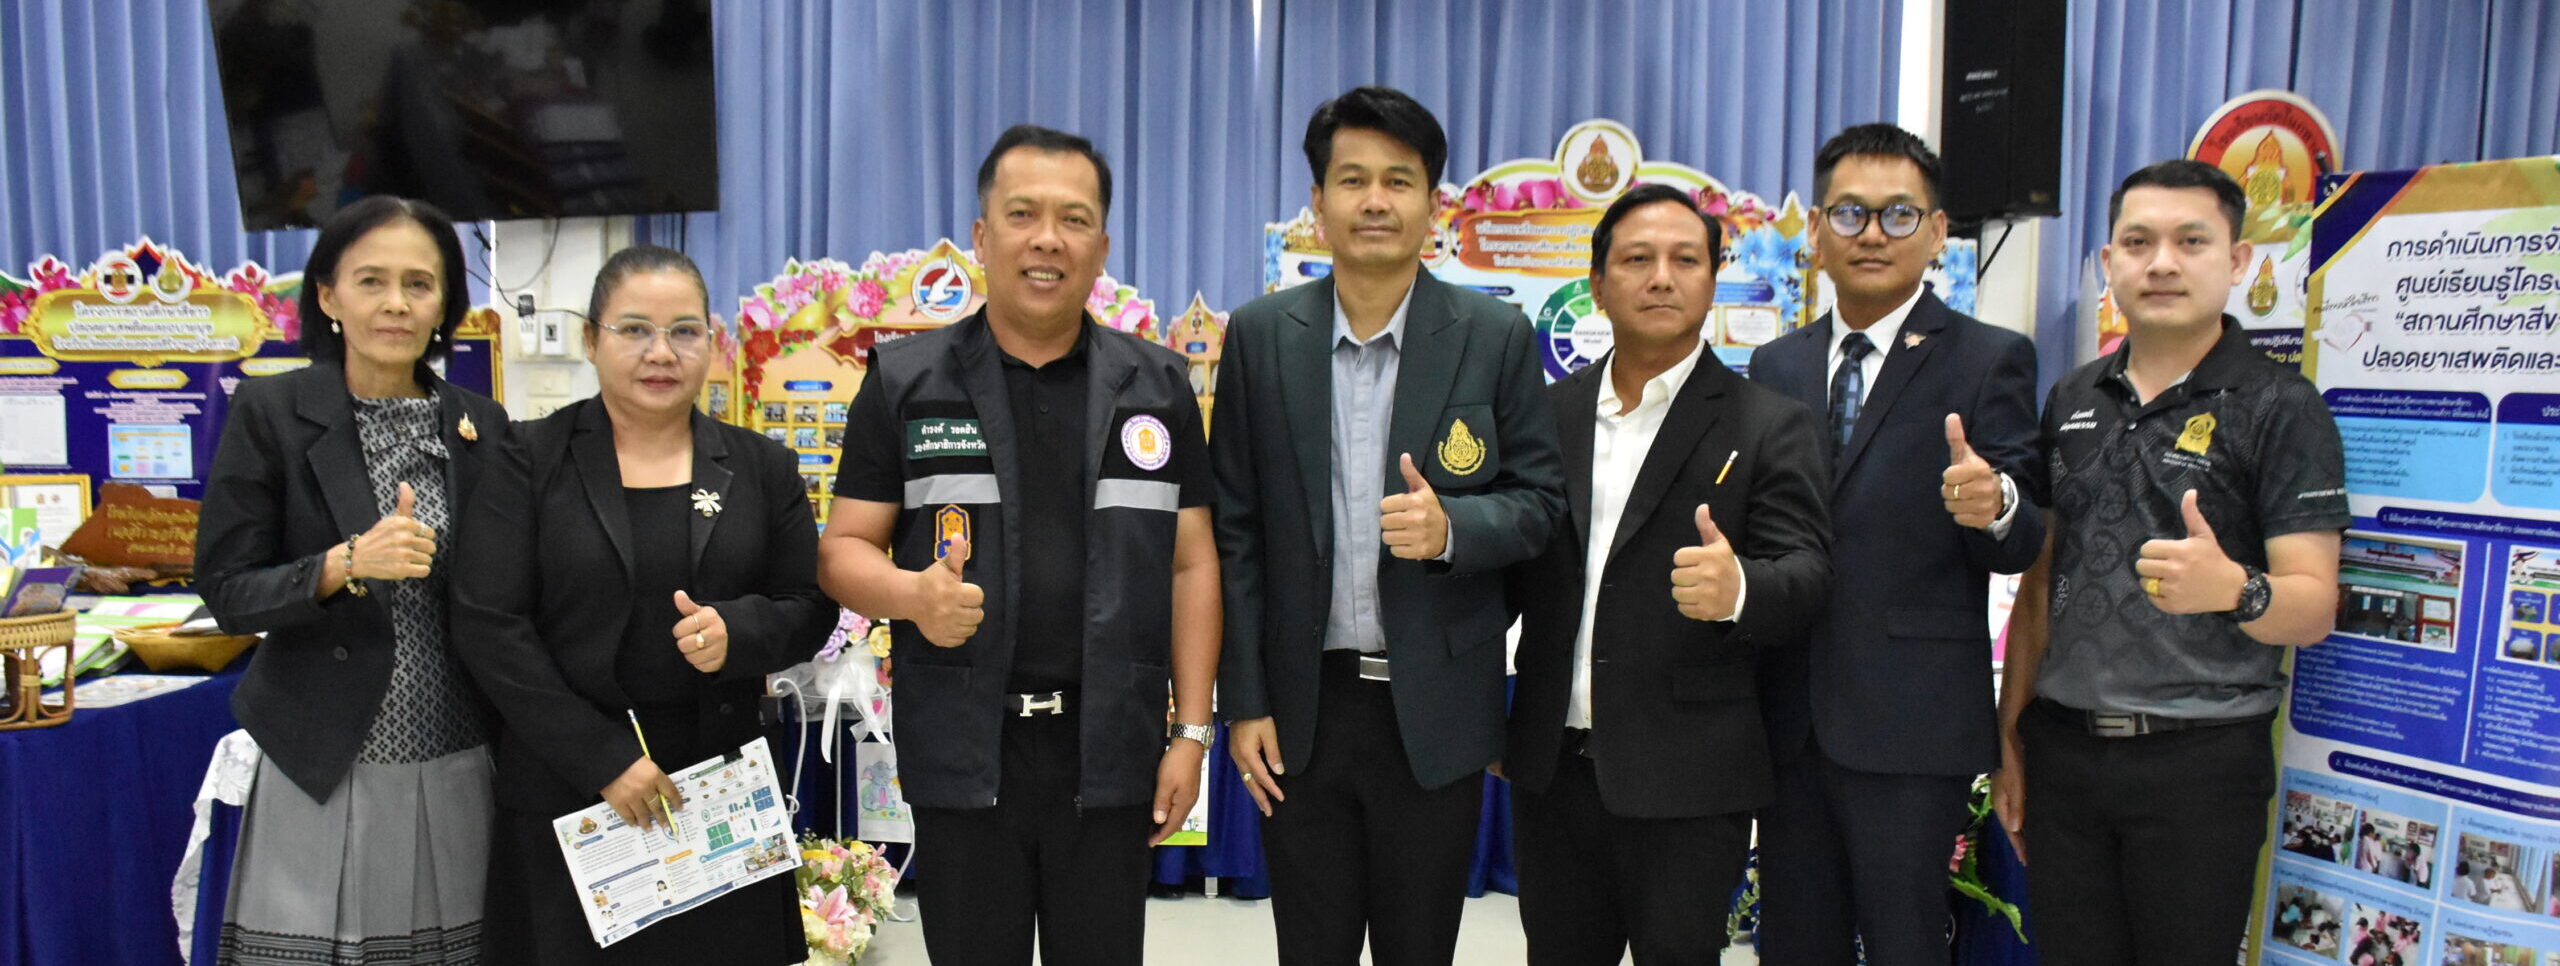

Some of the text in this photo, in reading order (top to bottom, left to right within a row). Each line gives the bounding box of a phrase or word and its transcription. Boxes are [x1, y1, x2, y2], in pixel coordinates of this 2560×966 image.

[2387, 226, 2560, 257] การดำเนินการจั
